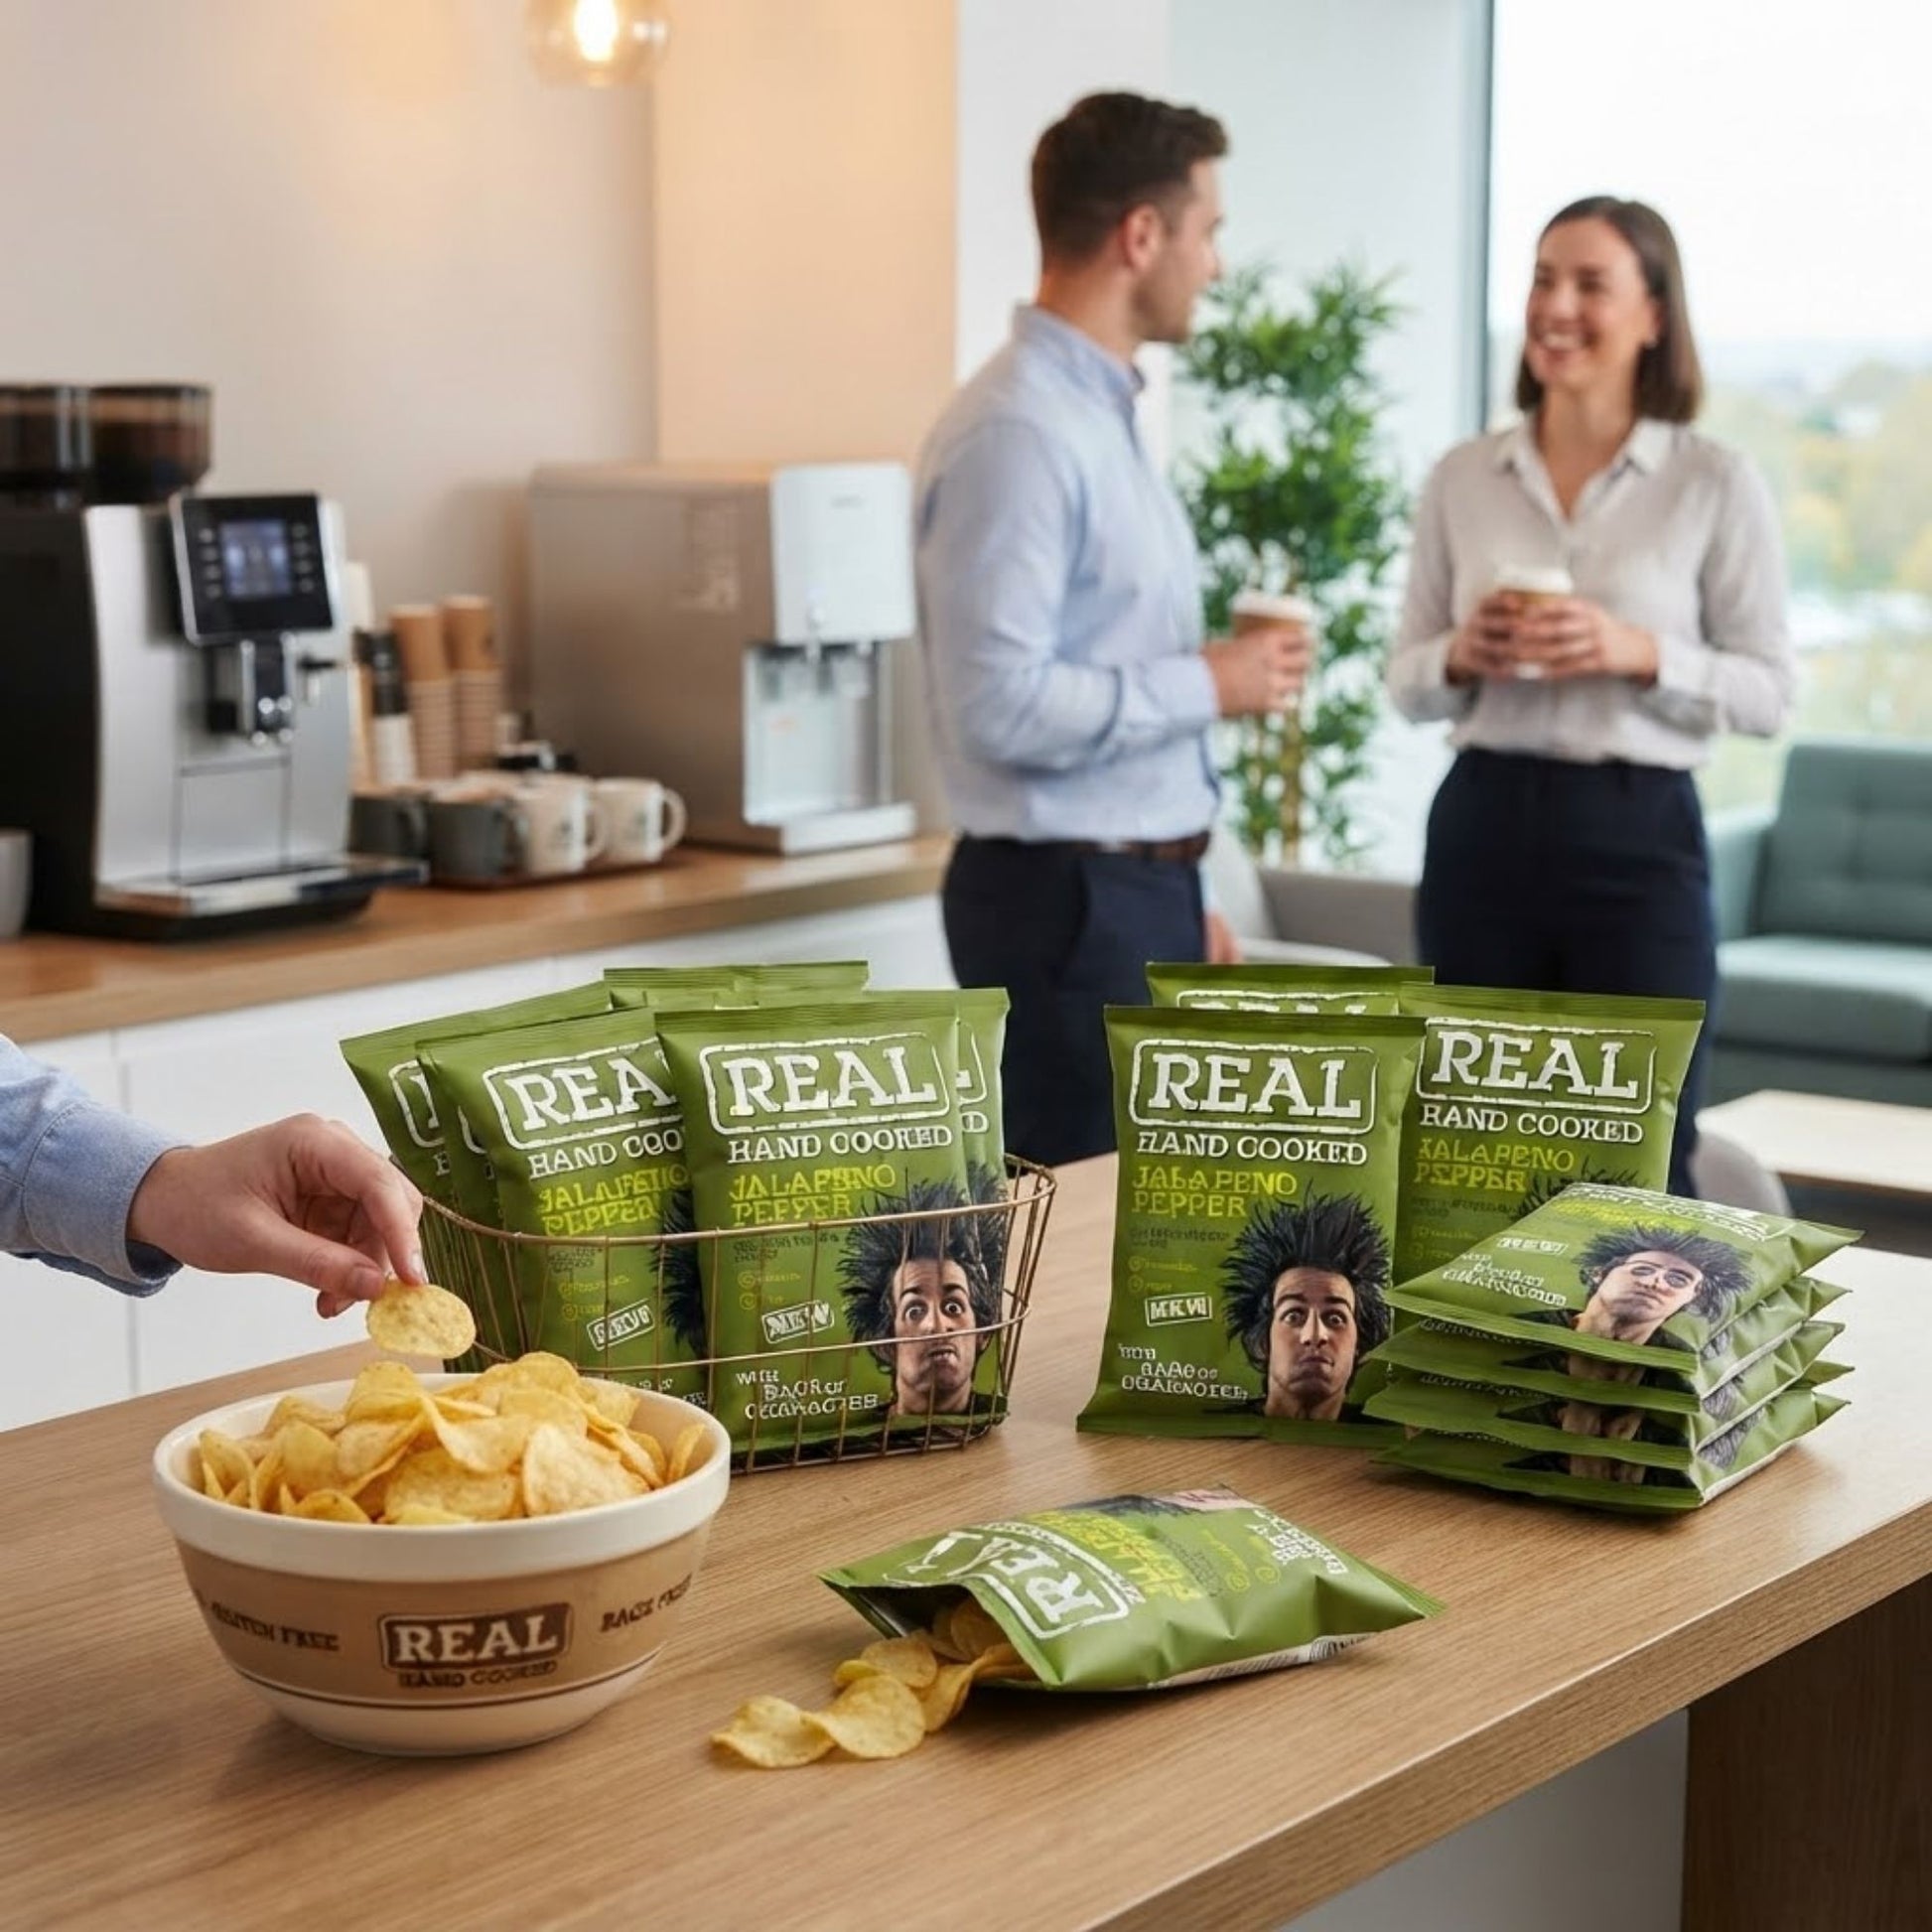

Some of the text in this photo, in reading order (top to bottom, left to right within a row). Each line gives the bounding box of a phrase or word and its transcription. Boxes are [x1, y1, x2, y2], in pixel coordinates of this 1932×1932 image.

[503, 1049, 677, 1132] REA
[721, 1045, 938, 1117] REAL
[1148, 1052, 1361, 1118] REAL
[1431, 1031, 1638, 1099] REAL
[1236, 1135, 1368, 1166] COOKED
[1517, 1112, 1643, 1144] COOKED
[394, 1613, 557, 1664] REAL
